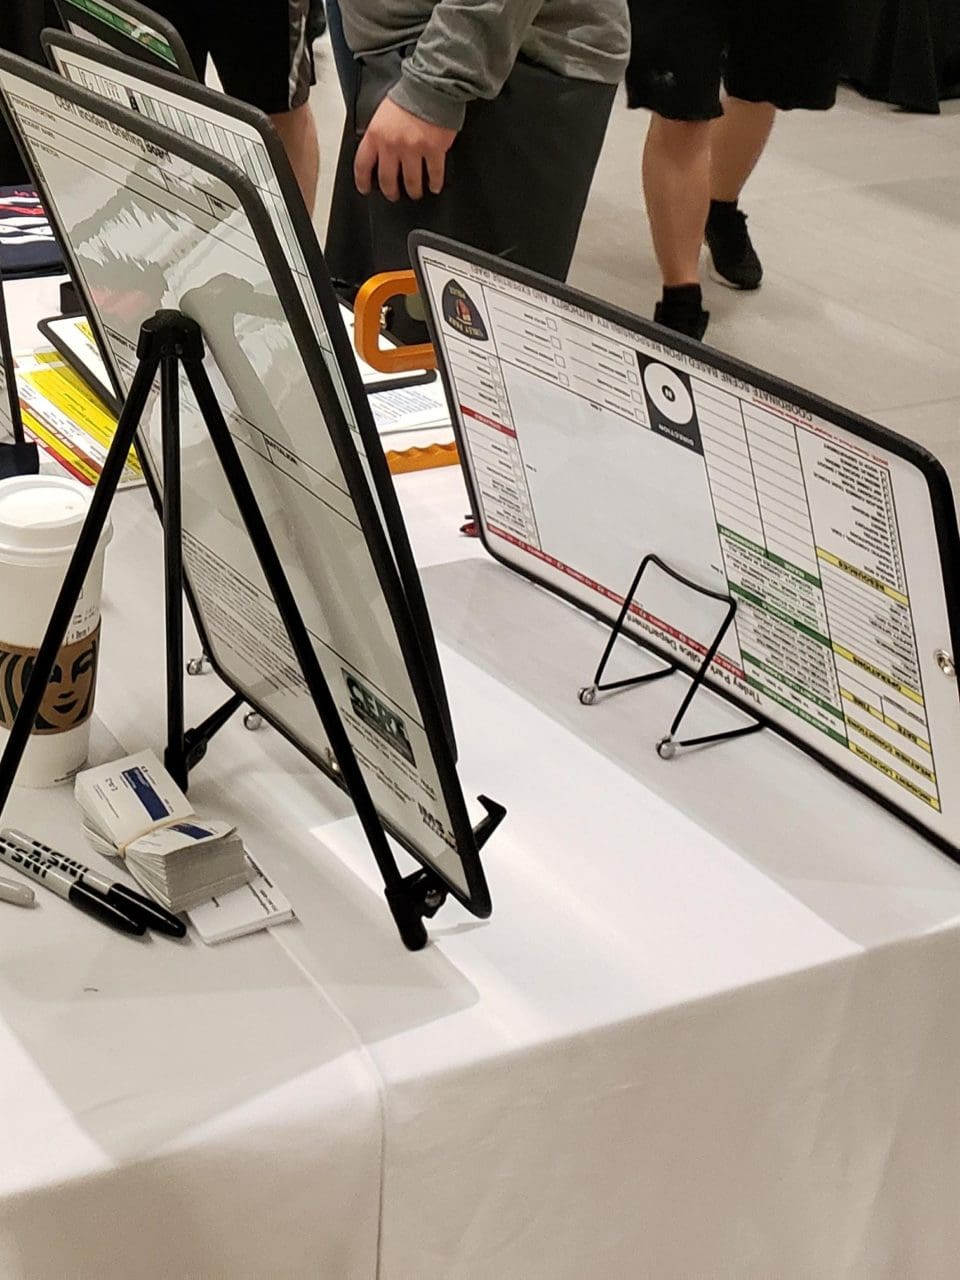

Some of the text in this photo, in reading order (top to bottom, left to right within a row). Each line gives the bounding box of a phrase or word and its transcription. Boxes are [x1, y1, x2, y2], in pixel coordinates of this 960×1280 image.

[687, 356, 718, 379] BASED
[718, 370, 749, 393] SCENE
[657, 421, 695, 447] DIRECTION
[837, 559, 885, 591] RESOURCES
[624, 608, 678, 653] Department
[852, 654, 901, 693] OPERATIONS
[731, 674, 762, 706] Tinley
[846, 716, 932, 780] WEATHER CONDITIONS
[897, 724, 917, 744] DATE
[854, 745, 931, 805] INCIDENT LOCATION
